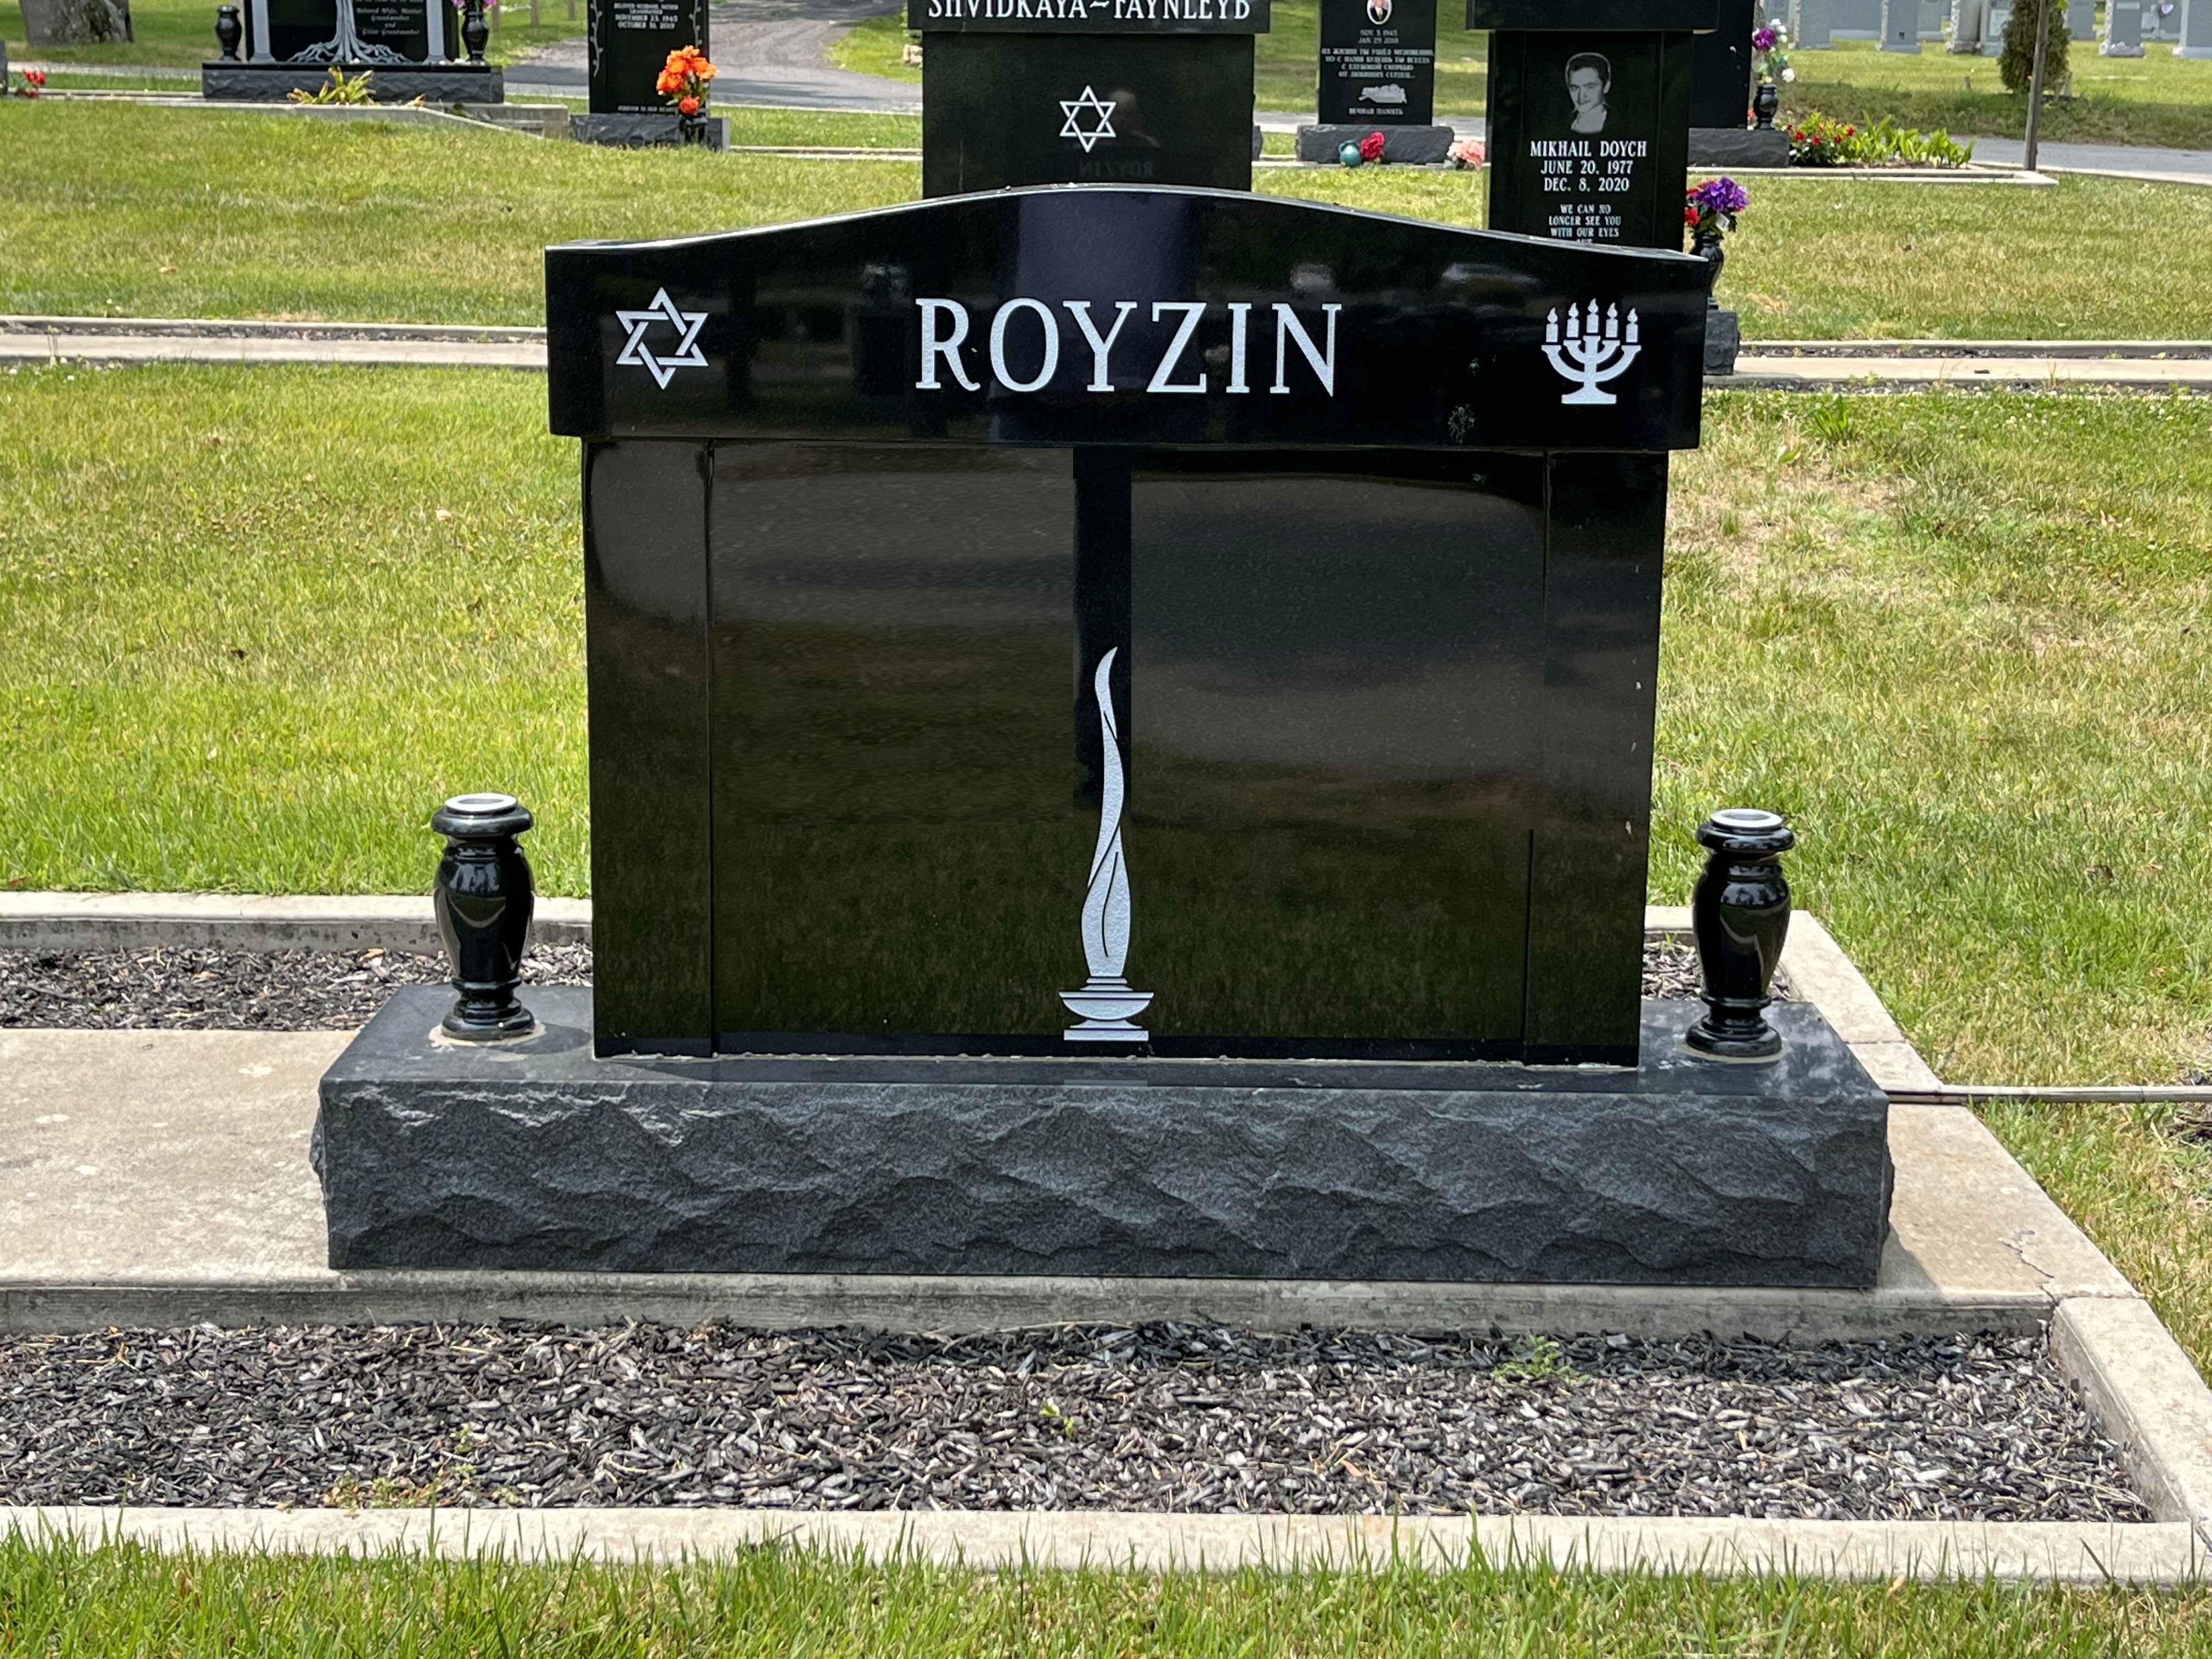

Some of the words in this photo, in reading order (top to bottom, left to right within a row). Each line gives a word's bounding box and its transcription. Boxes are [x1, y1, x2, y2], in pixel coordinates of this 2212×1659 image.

[1530, 140, 1592, 157] MIKHAIL
[1600, 140, 1647, 157] DOYCH
[1541, 160, 1573, 175] JUNE
[1607, 160, 1634, 175] 1977
[1544, 177, 1572, 192] DEC.
[1598, 177, 1630, 192] 2020
[1560, 204, 1573, 215] WE
[1577, 204, 1595, 215] CAN
[1599, 204, 1612, 215] NO
[1549, 215, 1582, 226] LONGER
[1585, 216, 1601, 226] SEE
[1604, 216, 1622, 226] YOU
[1550, 227, 1573, 238] WITH
[1576, 228, 1594, 238] OUR
[1598, 228, 1620, 238] EYES
[915, 297, 1342, 397] ROYZIN
